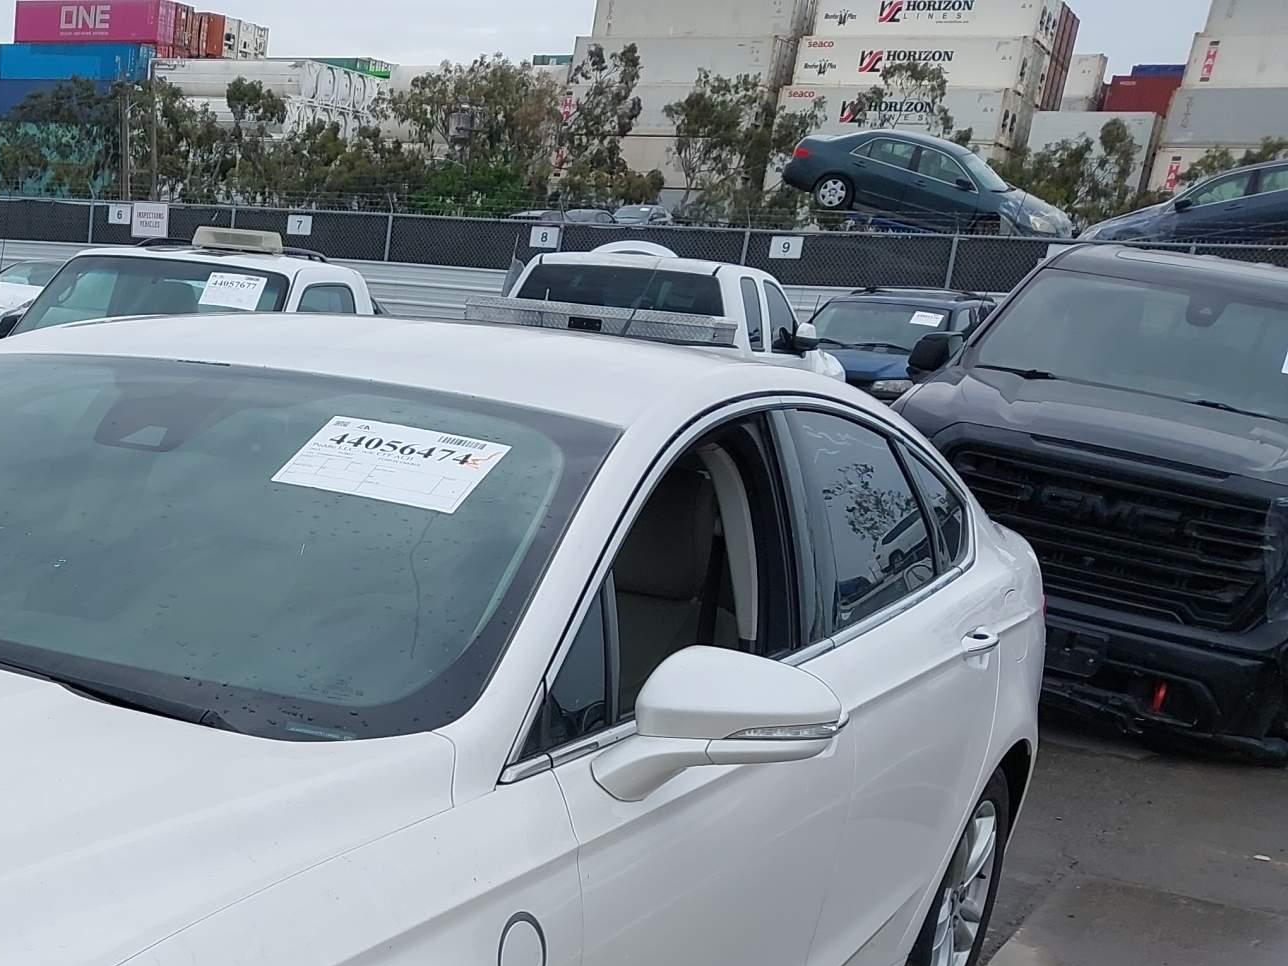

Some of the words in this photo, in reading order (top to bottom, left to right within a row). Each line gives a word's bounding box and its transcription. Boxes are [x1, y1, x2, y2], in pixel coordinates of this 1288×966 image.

[906, 0, 973, 11] HORIZON
[60, 5, 110, 29] ONE
[885, 50, 954, 62] HORIZON
[787, 89, 814, 98] seaco
[116, 210, 123, 220] 6
[296, 219, 303, 230] 7
[540, 232, 548, 243] 8
[781, 242, 791, 253] 9
[329, 432, 474, 466] 44056474
